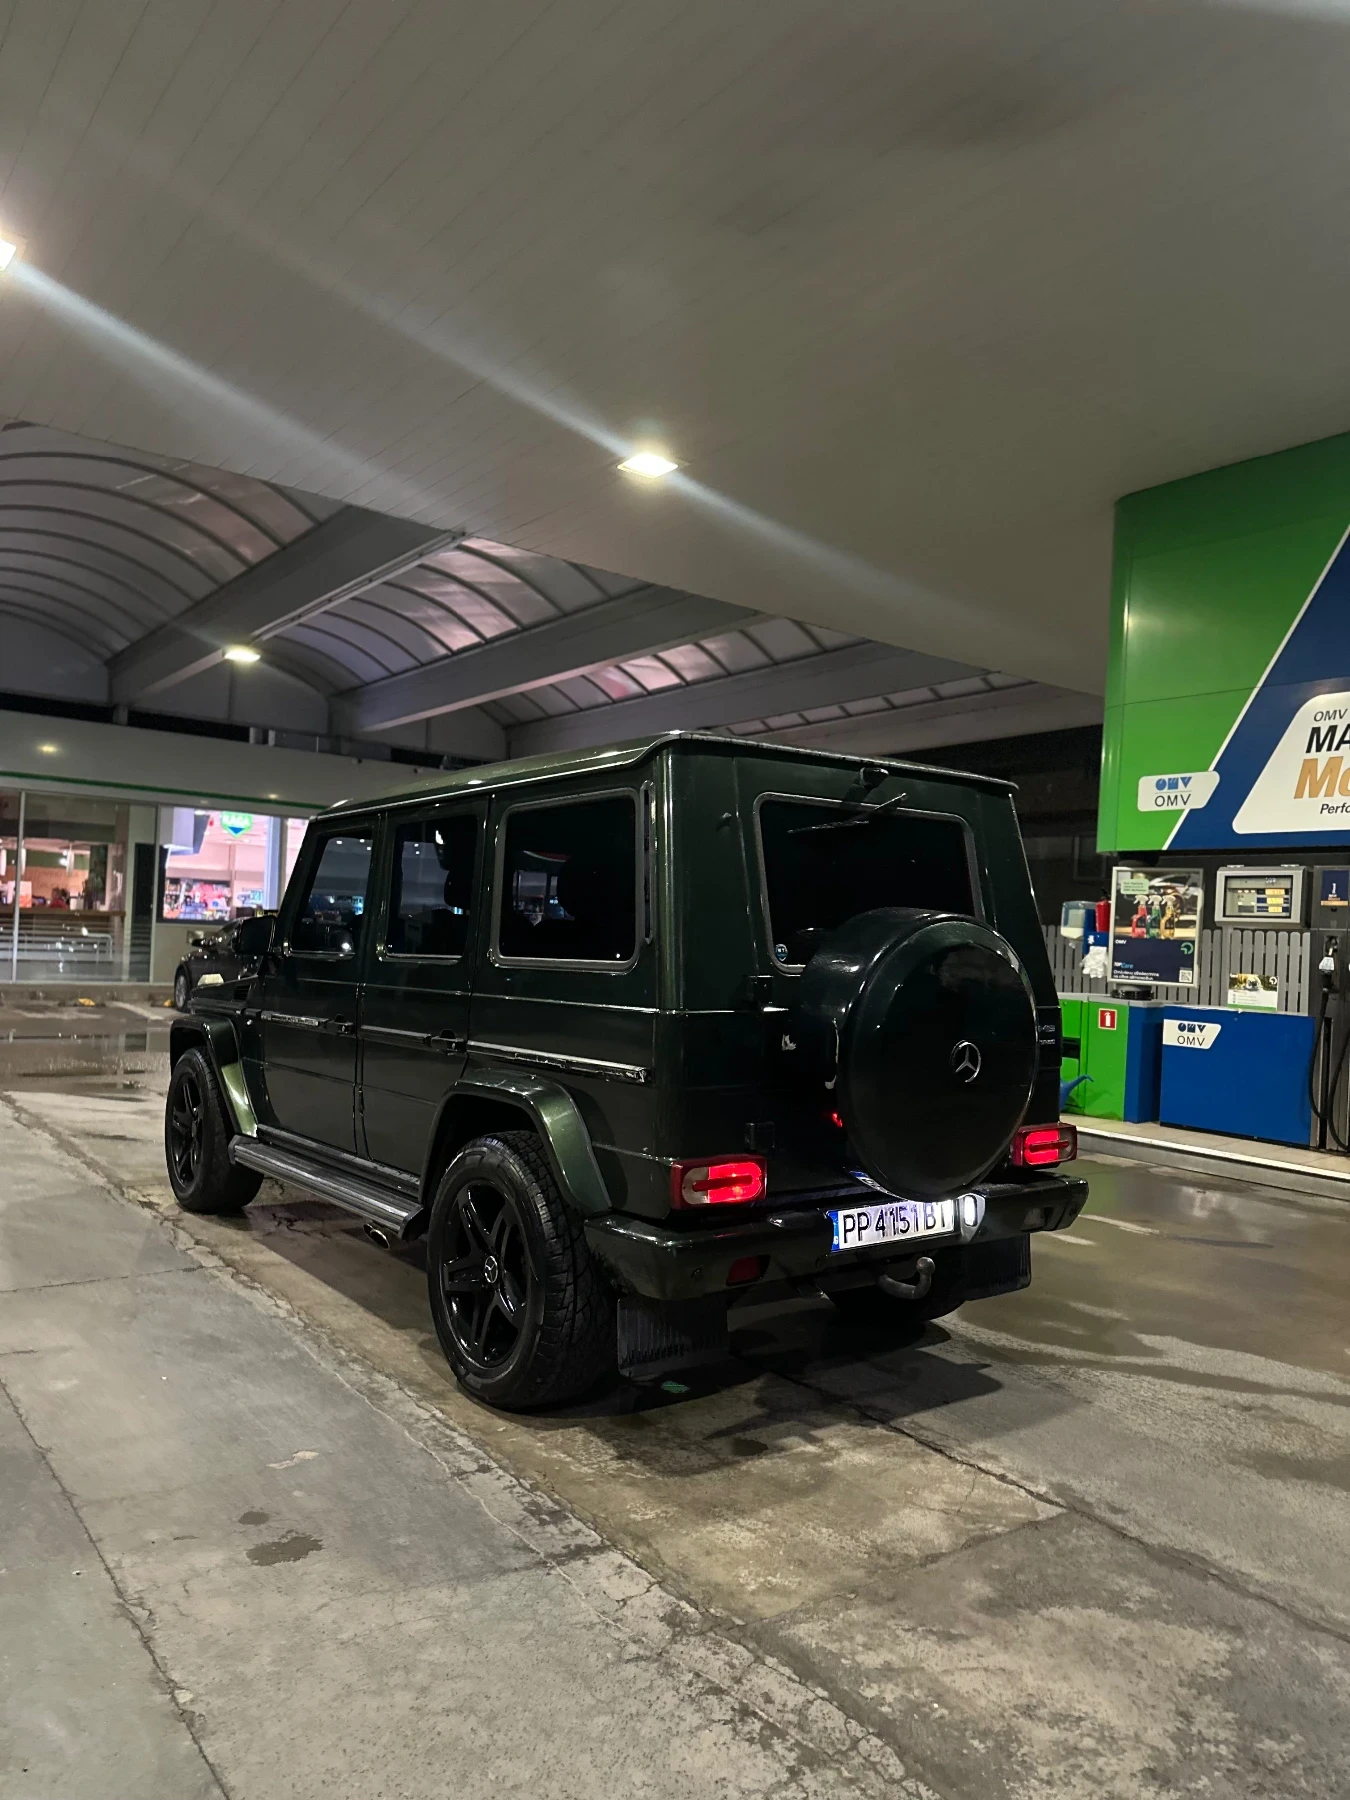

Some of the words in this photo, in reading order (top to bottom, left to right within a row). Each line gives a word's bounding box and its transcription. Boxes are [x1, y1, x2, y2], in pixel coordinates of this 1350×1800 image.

[1313, 708, 1348, 722] OMV
[1305, 723, 1350, 753] MA
[1155, 776, 1192, 791] OMV
[1154, 793, 1191, 807] OMV
[1177, 1022, 1206, 1034] OMV
[1177, 1035, 1206, 1047] OMV
[843, 1212, 870, 1244] PP
[875, 1204, 919, 1238] 4151
